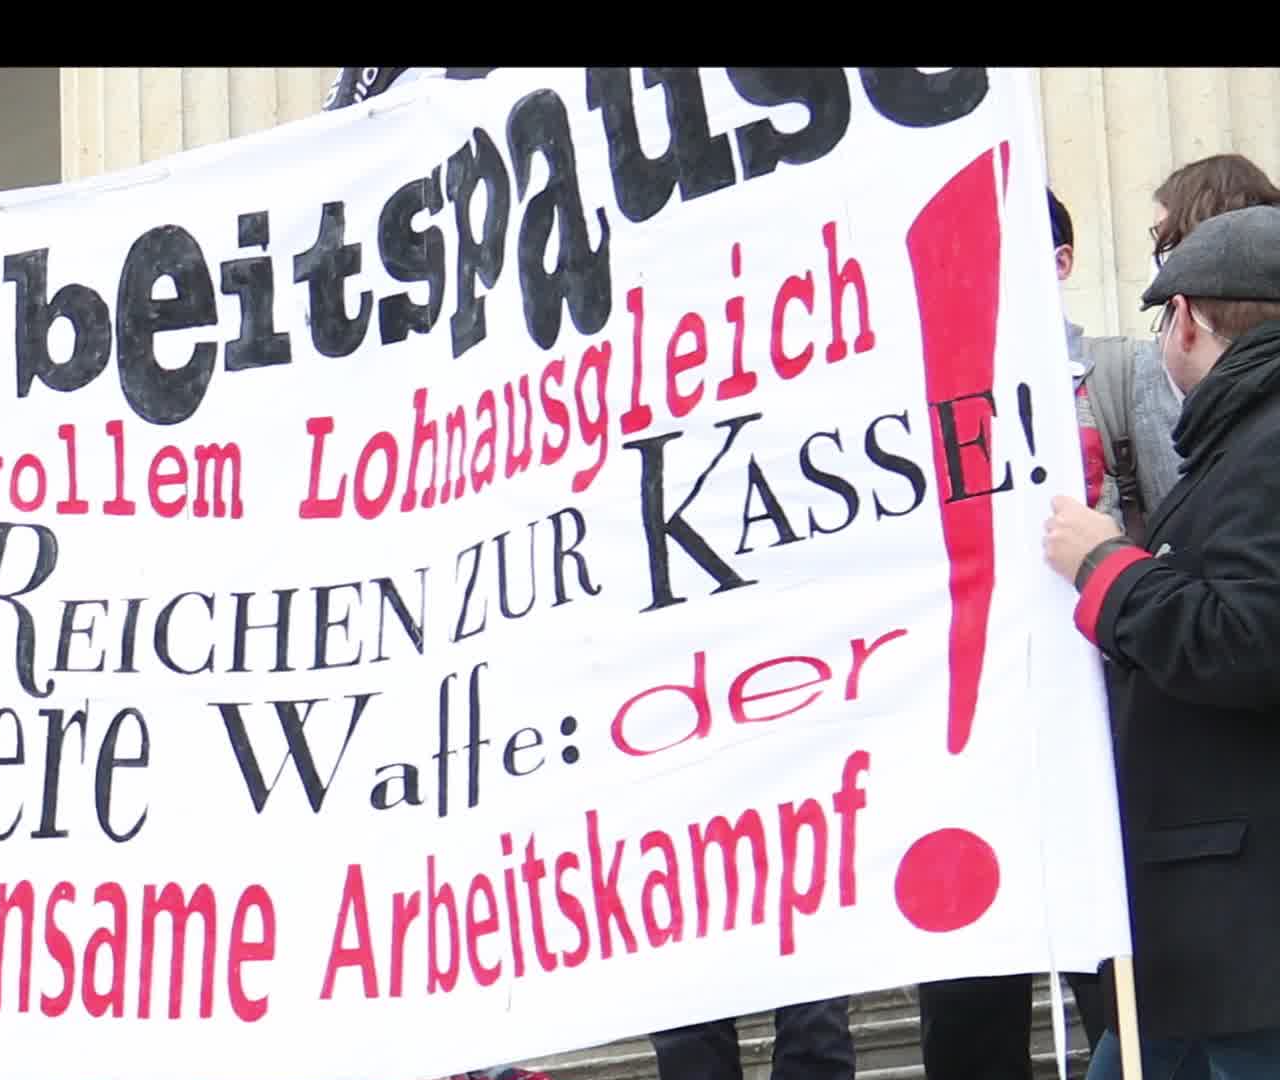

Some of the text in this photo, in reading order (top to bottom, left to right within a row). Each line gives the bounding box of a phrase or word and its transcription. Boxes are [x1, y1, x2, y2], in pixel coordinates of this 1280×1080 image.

[298, 221, 876, 521] Lohnausgleich
[453, 505, 602, 643] ZUR
[622, 381, 1048, 613] KASSE!
[208, 662, 580, 818] Waffe:
[611, 628, 908, 757] der
[320, 749, 871, 1000] Arbeitskampf
